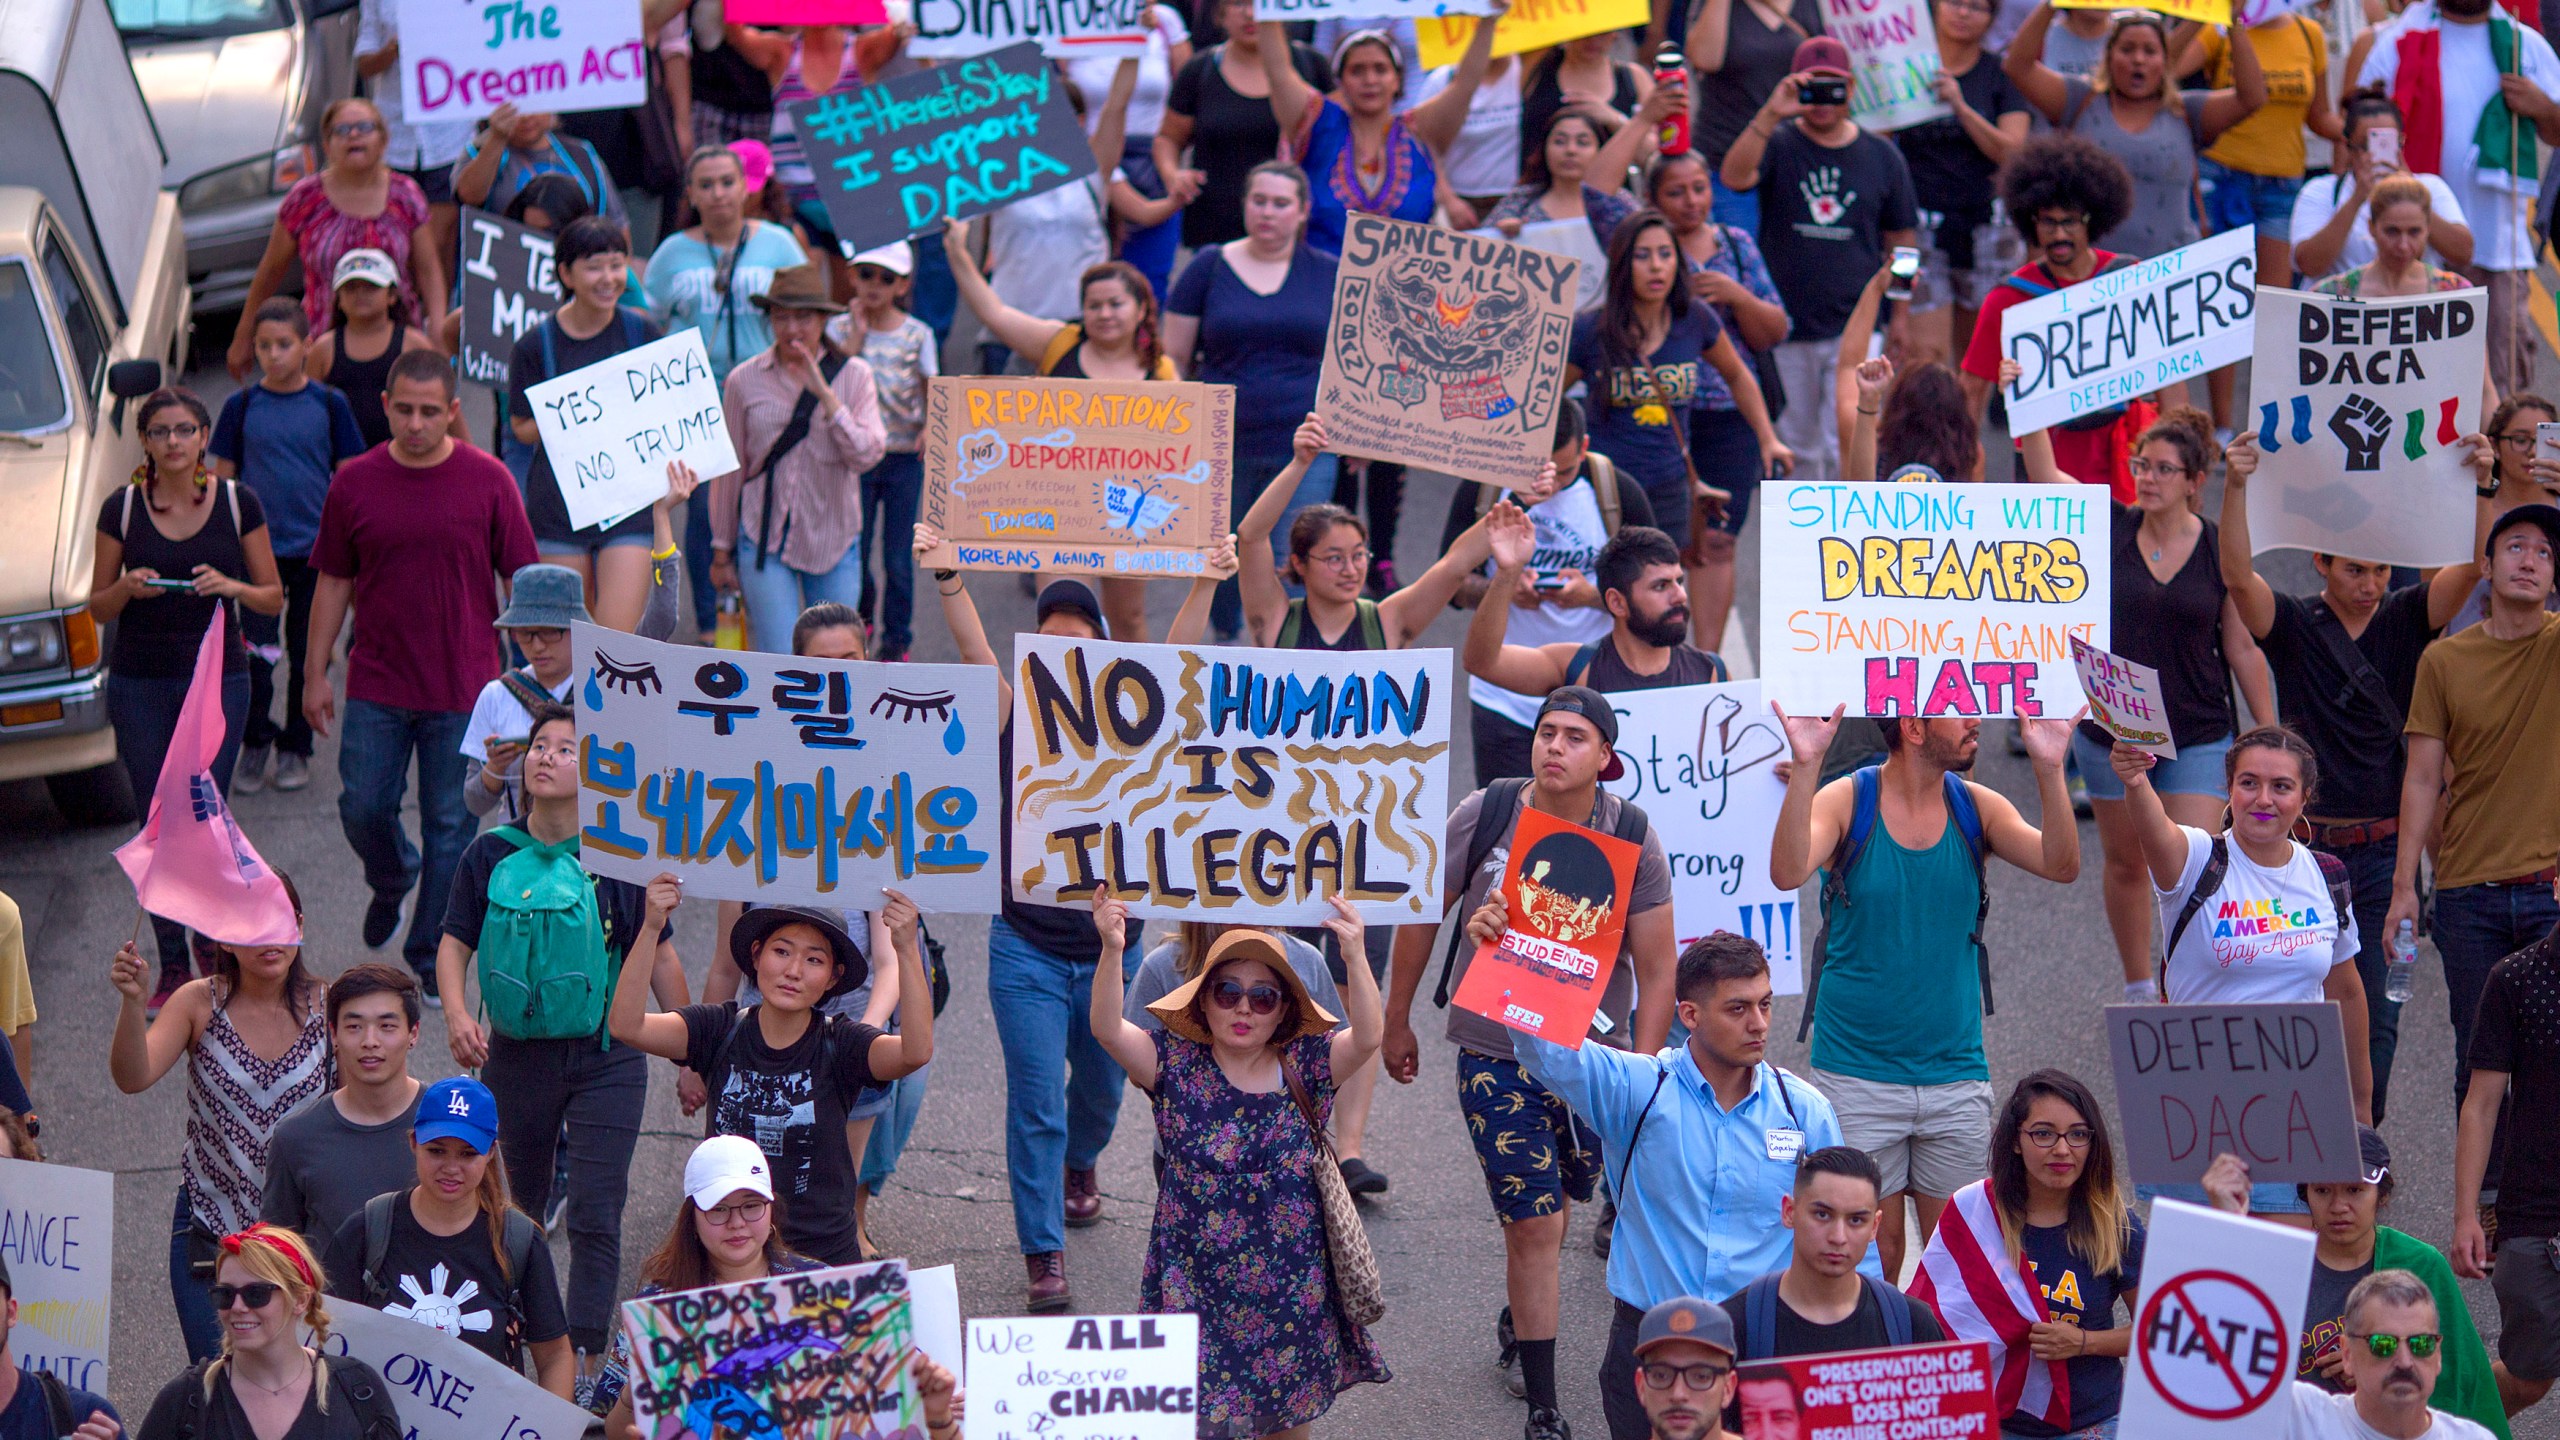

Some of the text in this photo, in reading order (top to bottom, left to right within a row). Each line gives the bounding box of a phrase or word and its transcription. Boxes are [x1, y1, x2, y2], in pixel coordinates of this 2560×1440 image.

[482, 0, 561, 49] The
[416, 39, 644, 111] Dream ACT
[832, 104, 1040, 191] I support
[900, 145, 1070, 229] DACA
[466, 218, 504, 281] I
[1347, 218, 1576, 304] SANCTUARY
[1399, 257, 1517, 295] FOR ALL
[2059, 250, 2188, 313] I SUPPORT
[2011, 256, 2256, 401] DREAMERS
[2299, 300, 2474, 345] DEFEND
[1341, 324, 1364, 371] BAN
[2299, 347, 2426, 386] DACA
[545, 347, 707, 430] YES DACA
[2070, 350, 2204, 413] DEFEND DACA
[966, 389, 1196, 434] REPARATIONS
[575, 406, 722, 489] NO TRUMP
[927, 383, 950, 531] DEFEND DACA
[971, 442, 994, 461] NOT
[1008, 445, 1191, 472] DEPORTATIONS!
[964, 479, 1011, 496] DIGNITY
[1025, 479, 1077, 495] FREEDOM
[1788, 486, 2086, 534] STANDING WITH
[959, 546, 1206, 573] KOREANS AGAINST BORDERS
[1818, 537, 2089, 604] DREAMERS
[1788, 610, 1964, 655] STANDING
[1865, 656, 2043, 717] HATE
[2070, 634, 2147, 693] Fight
[678, 660, 867, 750] 우릴
[1020, 646, 1431, 767] NO HUMAN
[1173, 744, 1280, 810] IS
[579, 733, 990, 893] 보내지마세요
[1046, 817, 1411, 909] ILLEGAL
[1668, 850, 1744, 896] rong
[2218, 897, 2285, 919] MAKE
[1500, 934, 1597, 978] STUDENTS
[2212, 930, 2322, 968] Gay Again
[1554, 968, 1593, 991] TRUMP
[1502, 1016, 1518, 1026] Action
[1503, 1004, 1545, 1028] SFER
[2128, 1015, 2319, 1074] DEFEND
[447, 1090, 469, 1117] LA
[2161, 1089, 2324, 1164] DACA
[819, 1308, 873, 1344] De
[975, 1319, 1166, 1355] We ALL
[2147, 1303, 2277, 1379] HATE
[1016, 1361, 1128, 1387] deserve
[1947, 1349, 1974, 1371] OF
[383, 1352, 475, 1419] ONE
[994, 1386, 1197, 1417] a CHANCE
[1803, 1371, 1985, 1408] ONE'S OWN CULTURE
[1852, 1397, 1941, 1424] DOES NOT
[1889, 1413, 1987, 1440] CONTEMPT
